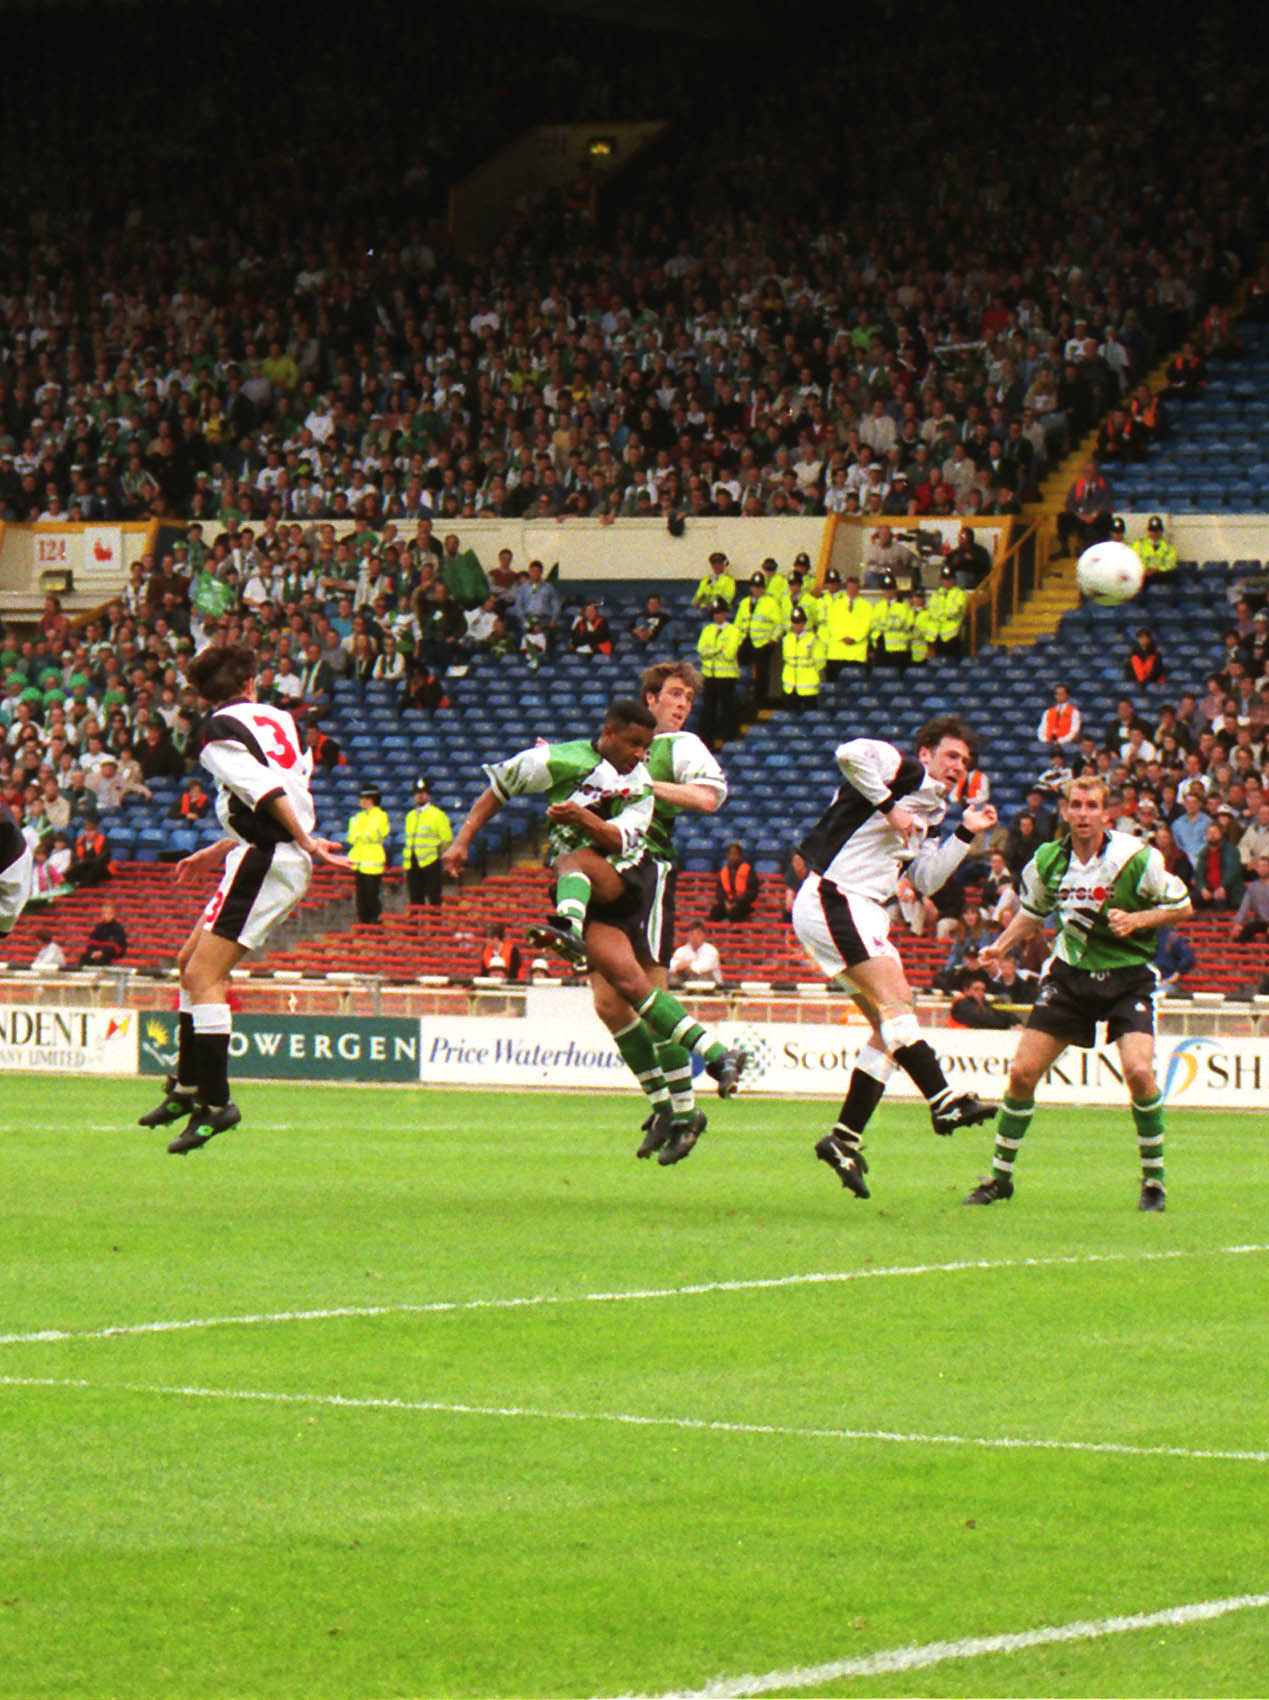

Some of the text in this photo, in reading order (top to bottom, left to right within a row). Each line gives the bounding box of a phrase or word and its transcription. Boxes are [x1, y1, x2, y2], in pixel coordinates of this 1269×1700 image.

[38, 538, 66, 561] 124
[252, 714, 298, 770] 3
[205, 890, 224, 923] 3
[228, 1031, 417, 1062] OWERGEN
[428, 1036, 488, 1065] Price
[938, 1051, 1012, 1076] ower
